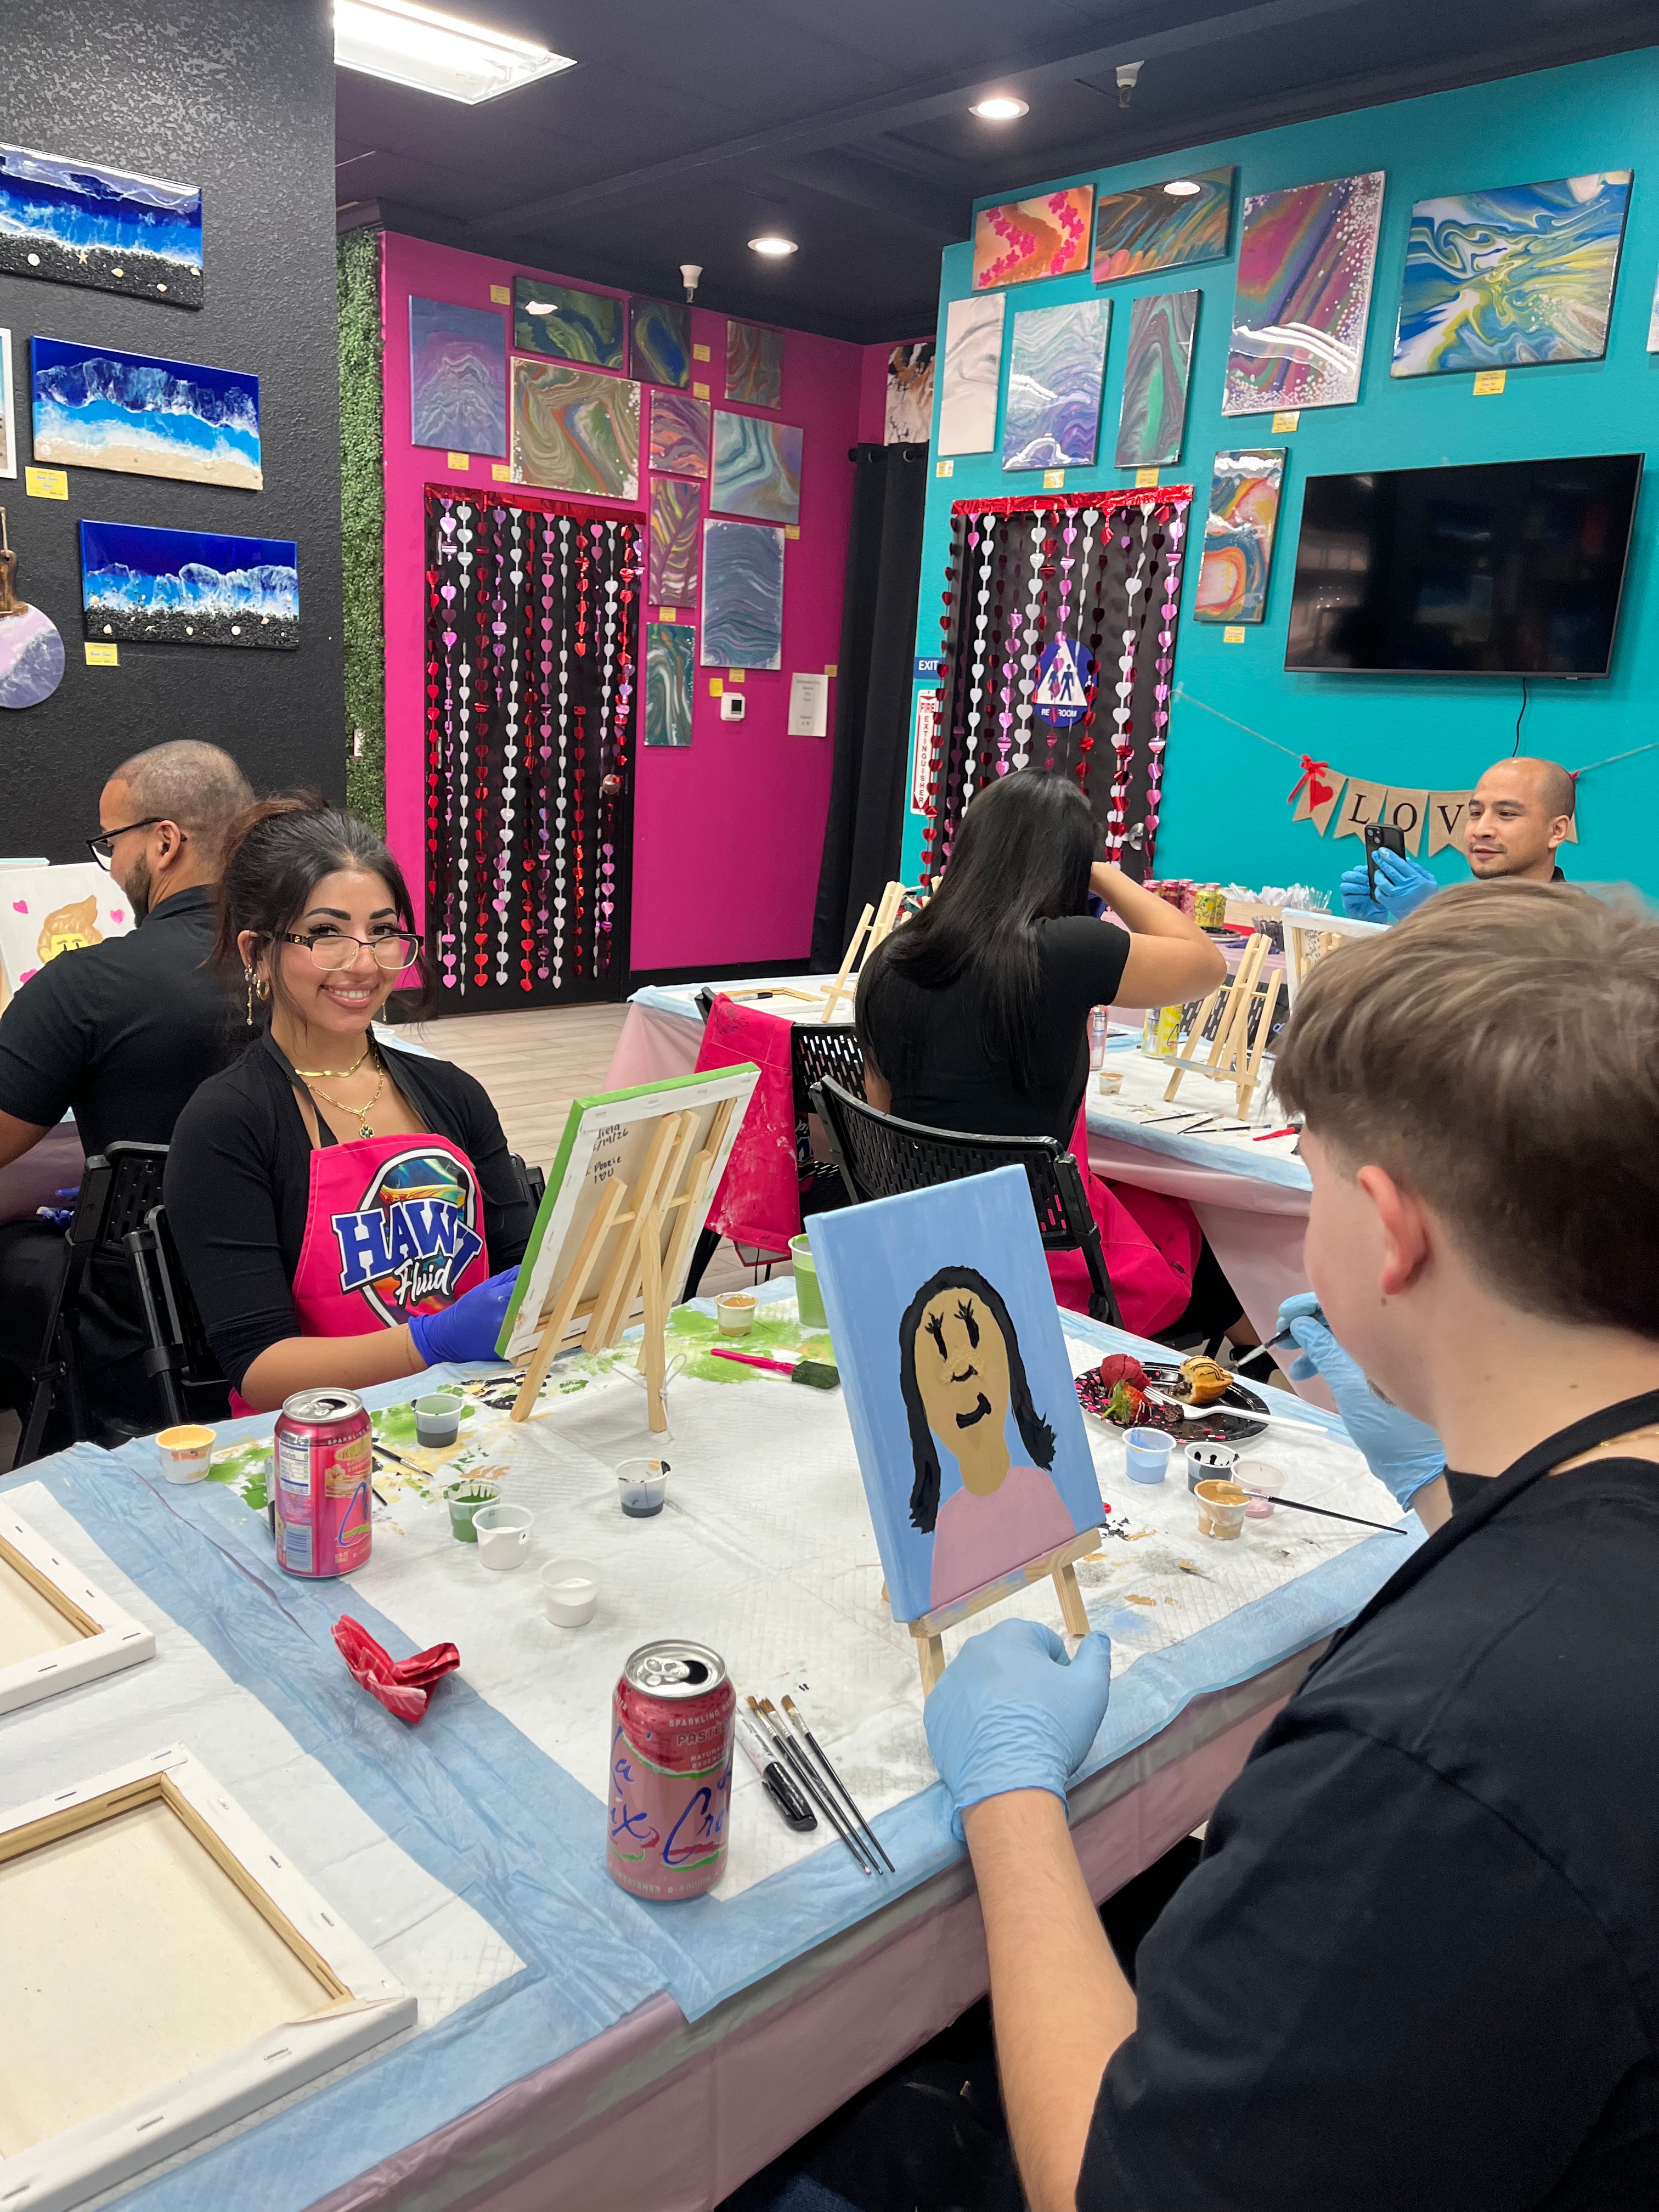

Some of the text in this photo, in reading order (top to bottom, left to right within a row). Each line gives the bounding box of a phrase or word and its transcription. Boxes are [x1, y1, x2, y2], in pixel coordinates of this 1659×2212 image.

[918, 660, 939, 670] EXIT
[920, 702, 935, 713] FIRE
[1041, 708, 1077, 718] REROOM
[918, 715, 929, 803] EXTINGUISHER
[1348, 793, 1465, 835] LOV
[394, 1258, 454, 1306] Fluid
[327, 1428, 366, 1446] SPARKLING
[668, 1710, 720, 1728] SPARKLING
